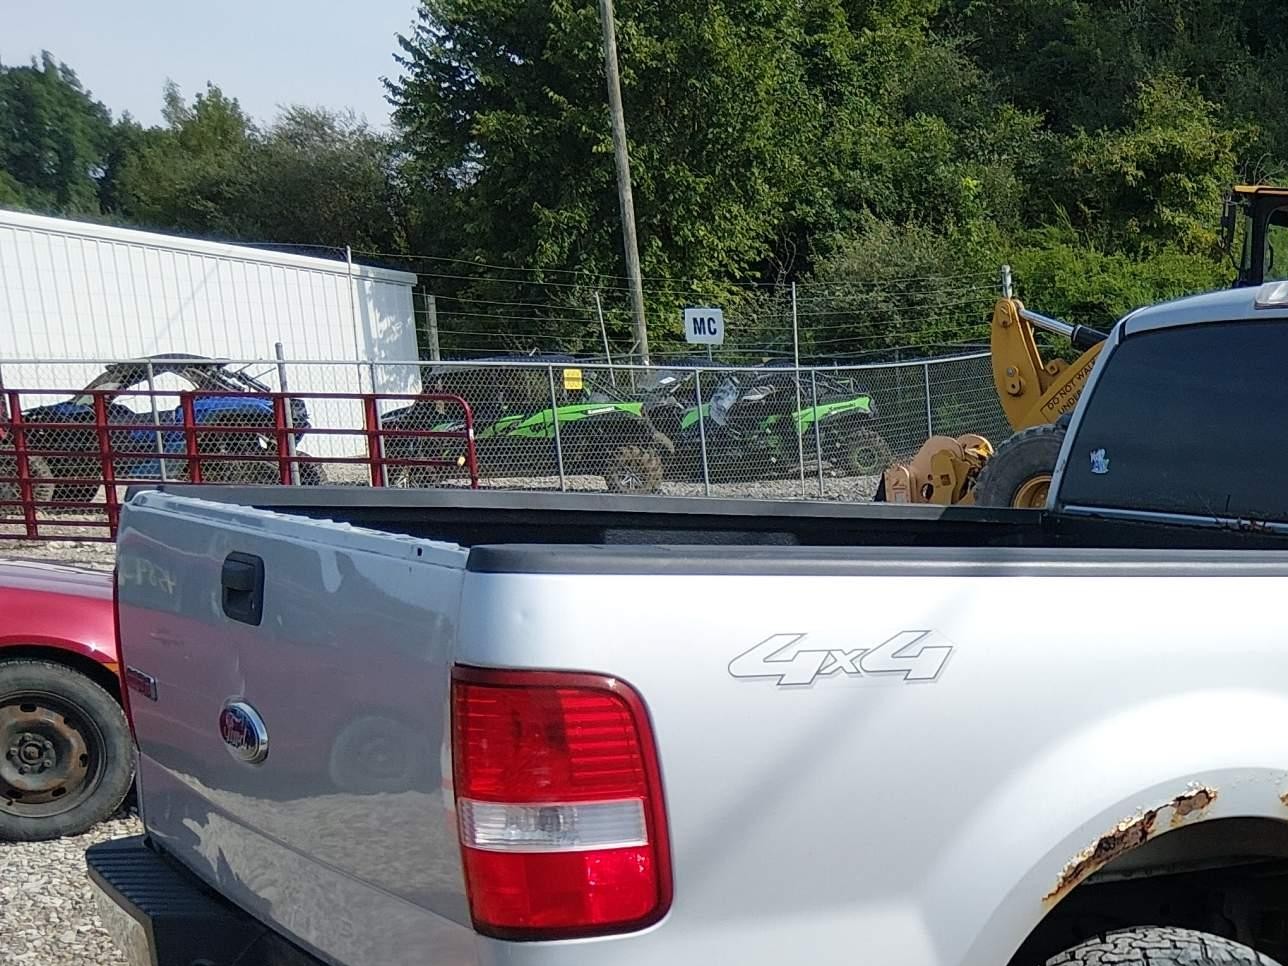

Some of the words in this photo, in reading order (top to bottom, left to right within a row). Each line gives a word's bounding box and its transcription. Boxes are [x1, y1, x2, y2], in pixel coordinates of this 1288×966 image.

[692, 316, 717, 336] MC
[1047, 396, 1060, 410] DO
[1059, 379, 1076, 398] NOT
[1076, 360, 1095, 381] WAL
[727, 630, 954, 686] 4x4
